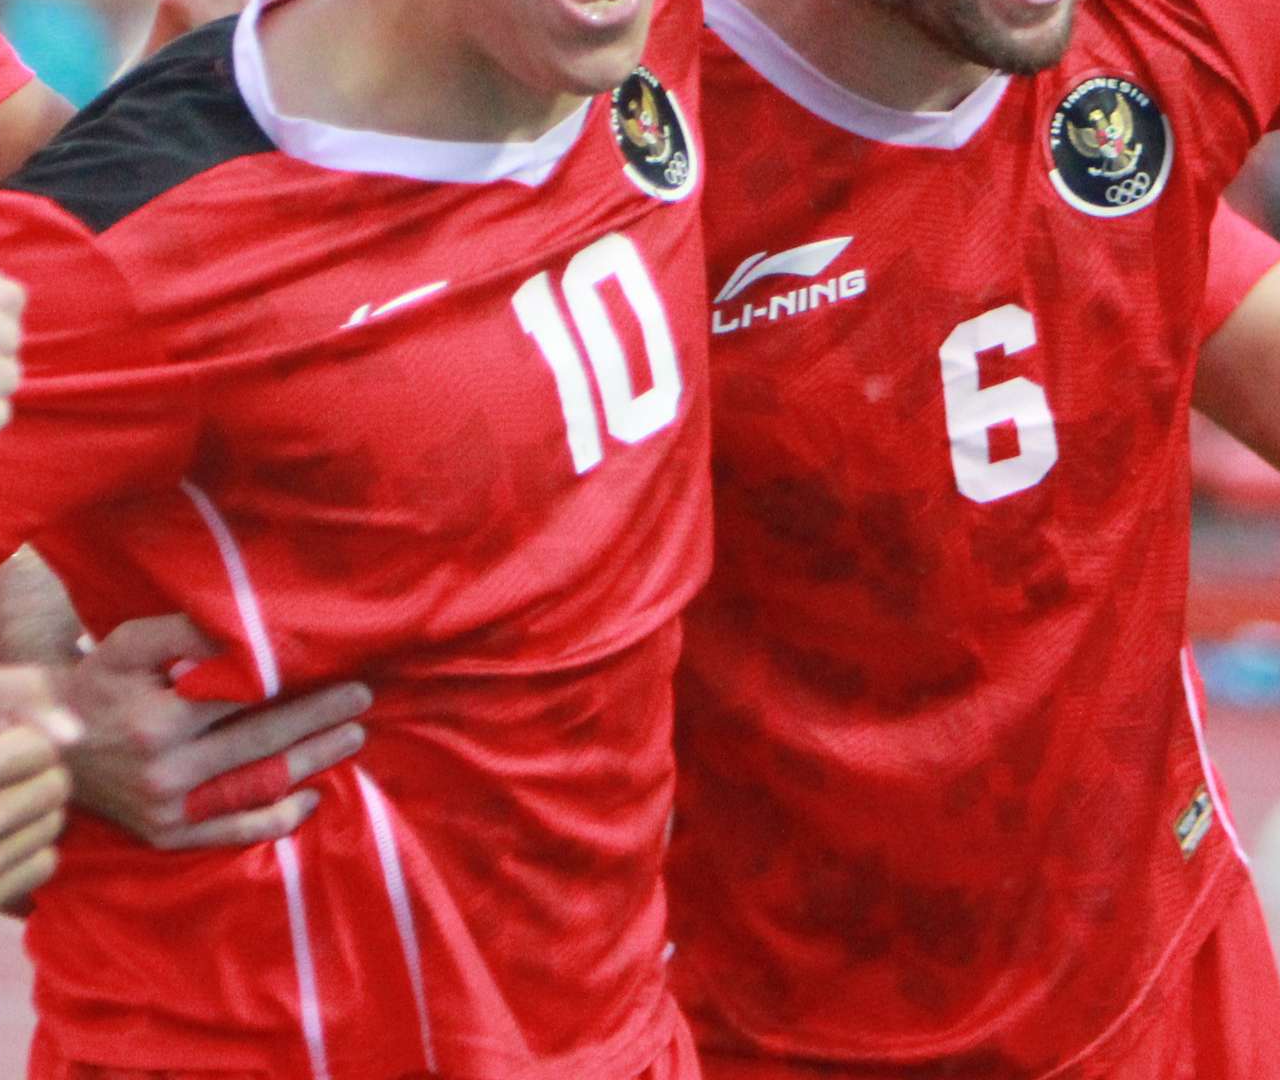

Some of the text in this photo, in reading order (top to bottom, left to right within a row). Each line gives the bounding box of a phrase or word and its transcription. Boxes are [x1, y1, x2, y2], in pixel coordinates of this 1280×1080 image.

[511, 232, 683, 475] 10
[712, 269, 867, 334] LI-NING
[938, 303, 1059, 504] 6
